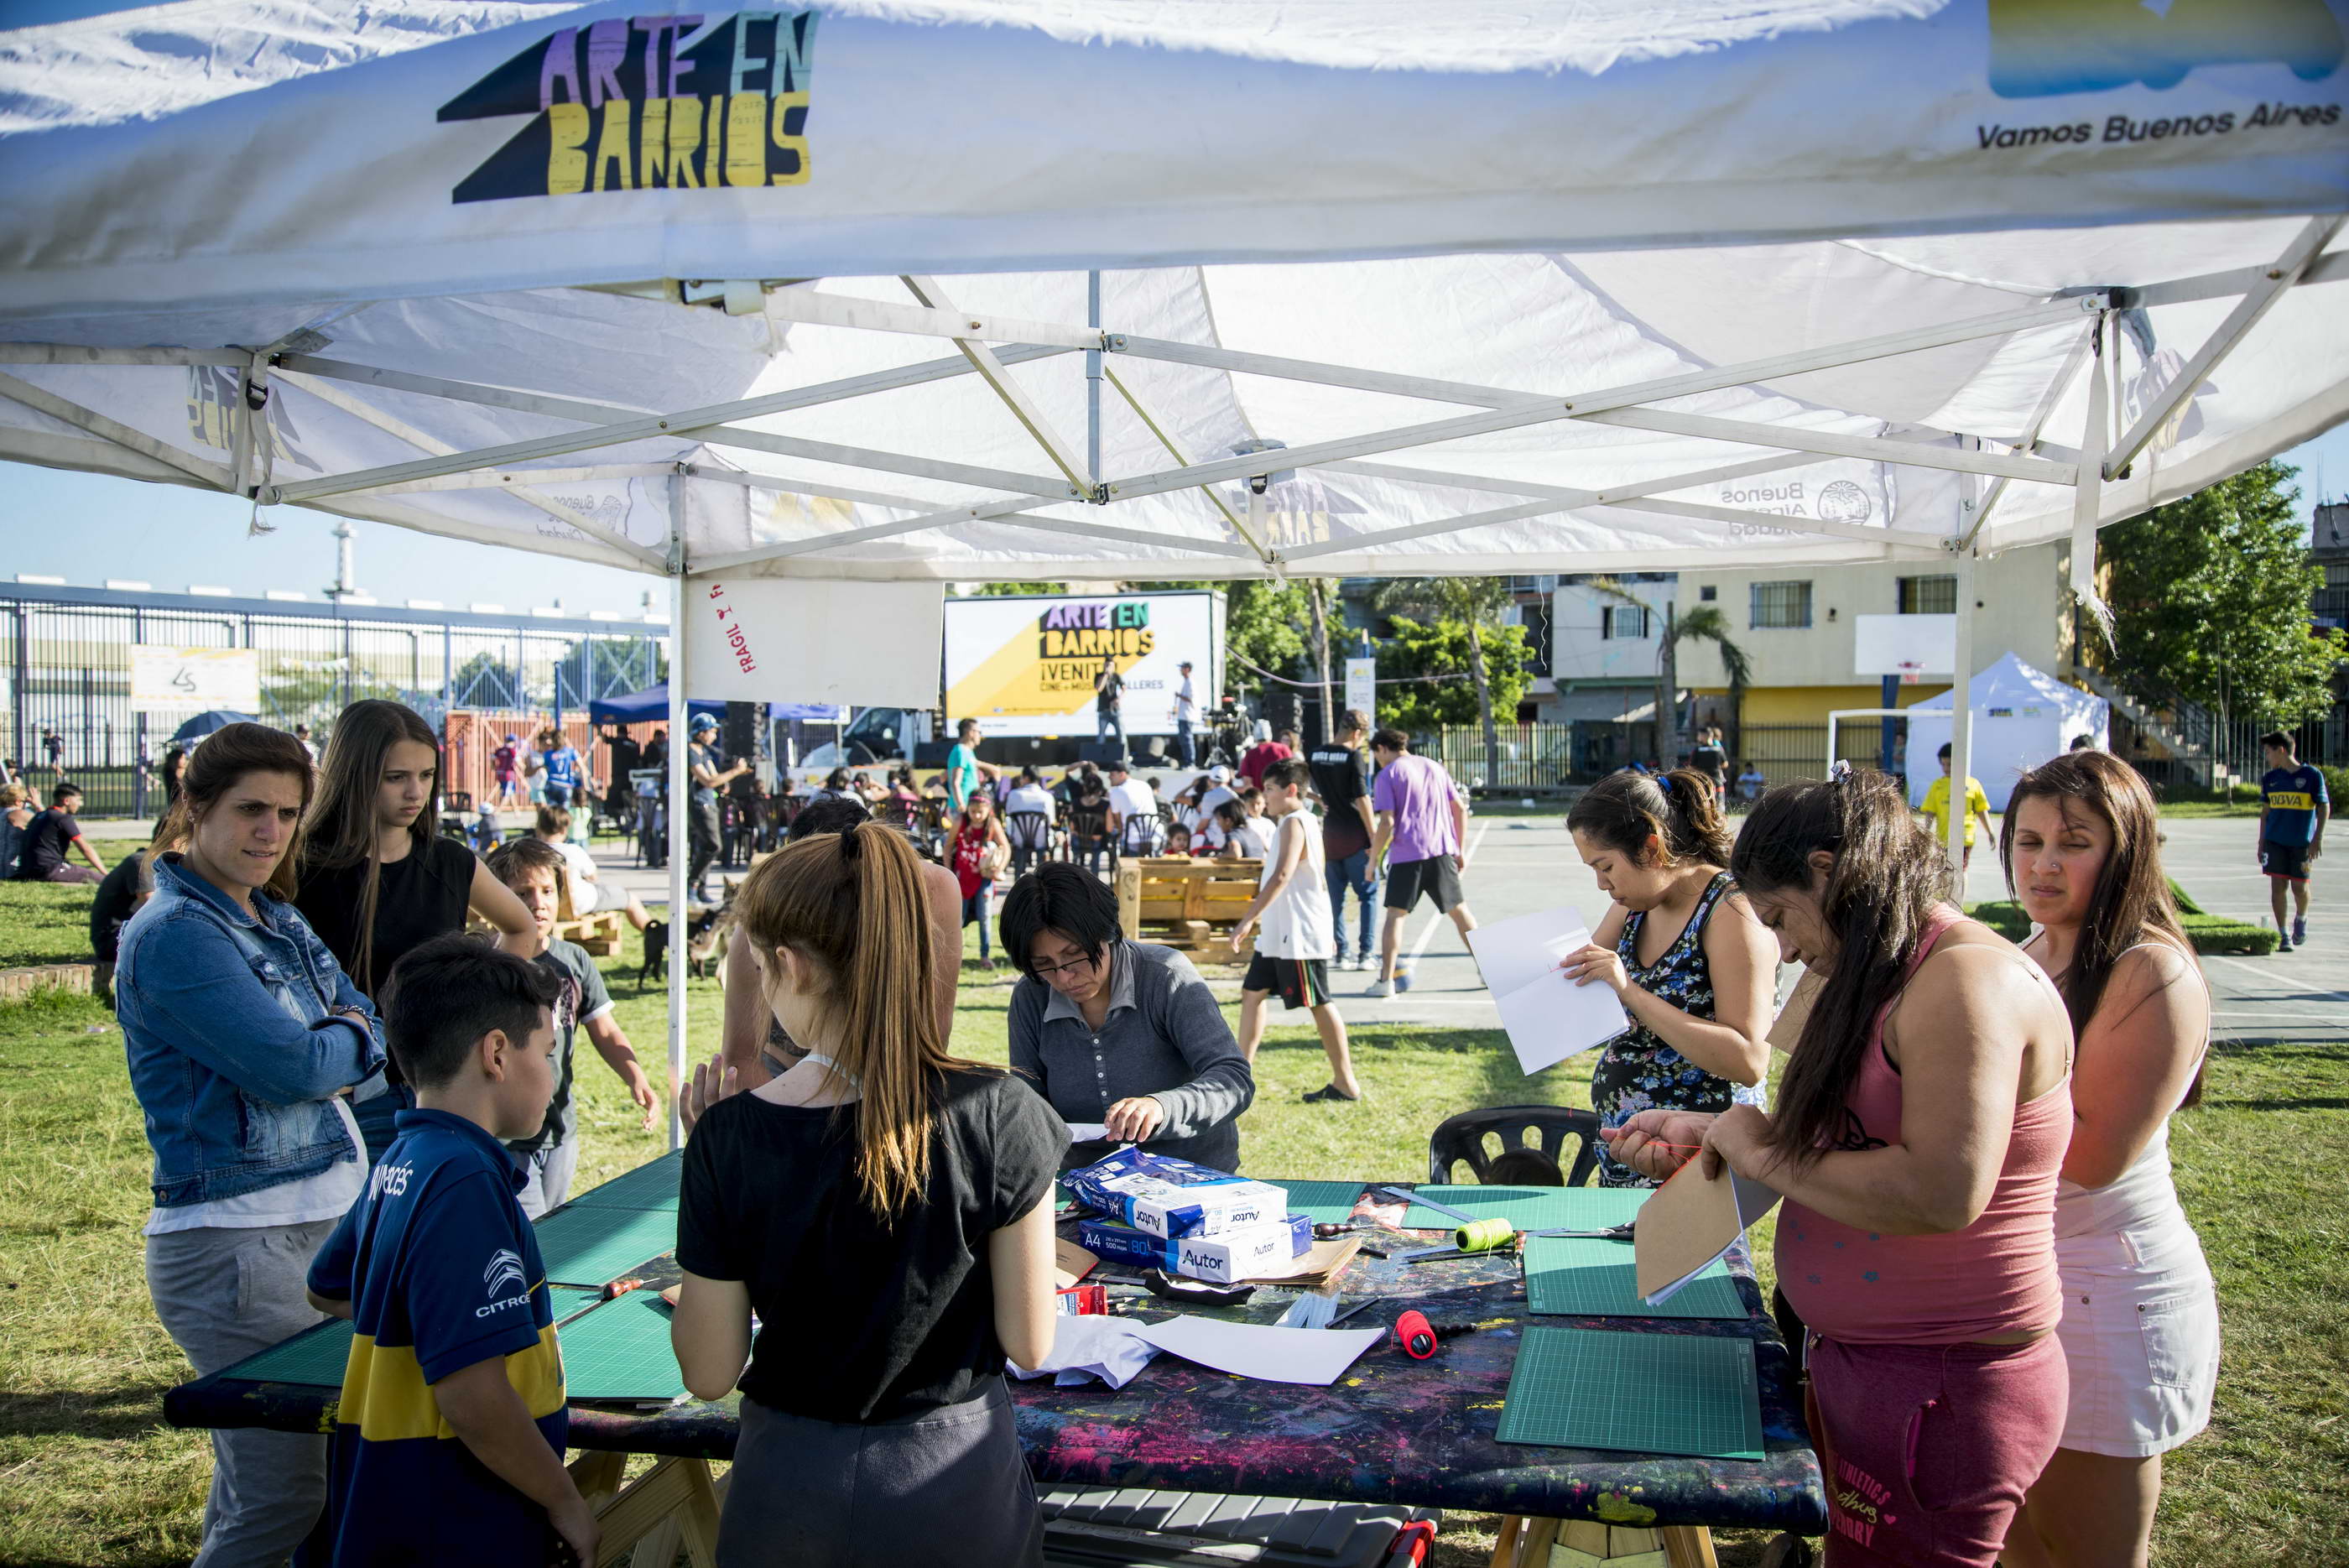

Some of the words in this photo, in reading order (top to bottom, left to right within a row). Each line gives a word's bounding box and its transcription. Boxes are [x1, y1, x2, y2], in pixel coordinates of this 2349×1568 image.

[539, 14, 705, 111] ARTE
[729, 10, 822, 98] EN
[1977, 122, 2092, 149] Vamos
[2102, 111, 2236, 143] Buenos
[2243, 102, 2341, 129] Aires
[547, 90, 813, 195] BARRIOS
[1046, 603, 1108, 628] ARTE
[1117, 602, 1149, 627] EN
[726, 623, 757, 674] FRAGIL
[1046, 629, 1155, 656] BARRIOS
[1136, 1210, 1161, 1231] Autor
[1231, 1211, 1260, 1222] Autor
[1085, 1232, 1101, 1248] A4
[1131, 1239, 1147, 1255] 80
[1253, 1242, 1274, 1257] Autor
[1182, 1249, 1224, 1269] Autor
[476, 1291, 531, 1317] CITROË
